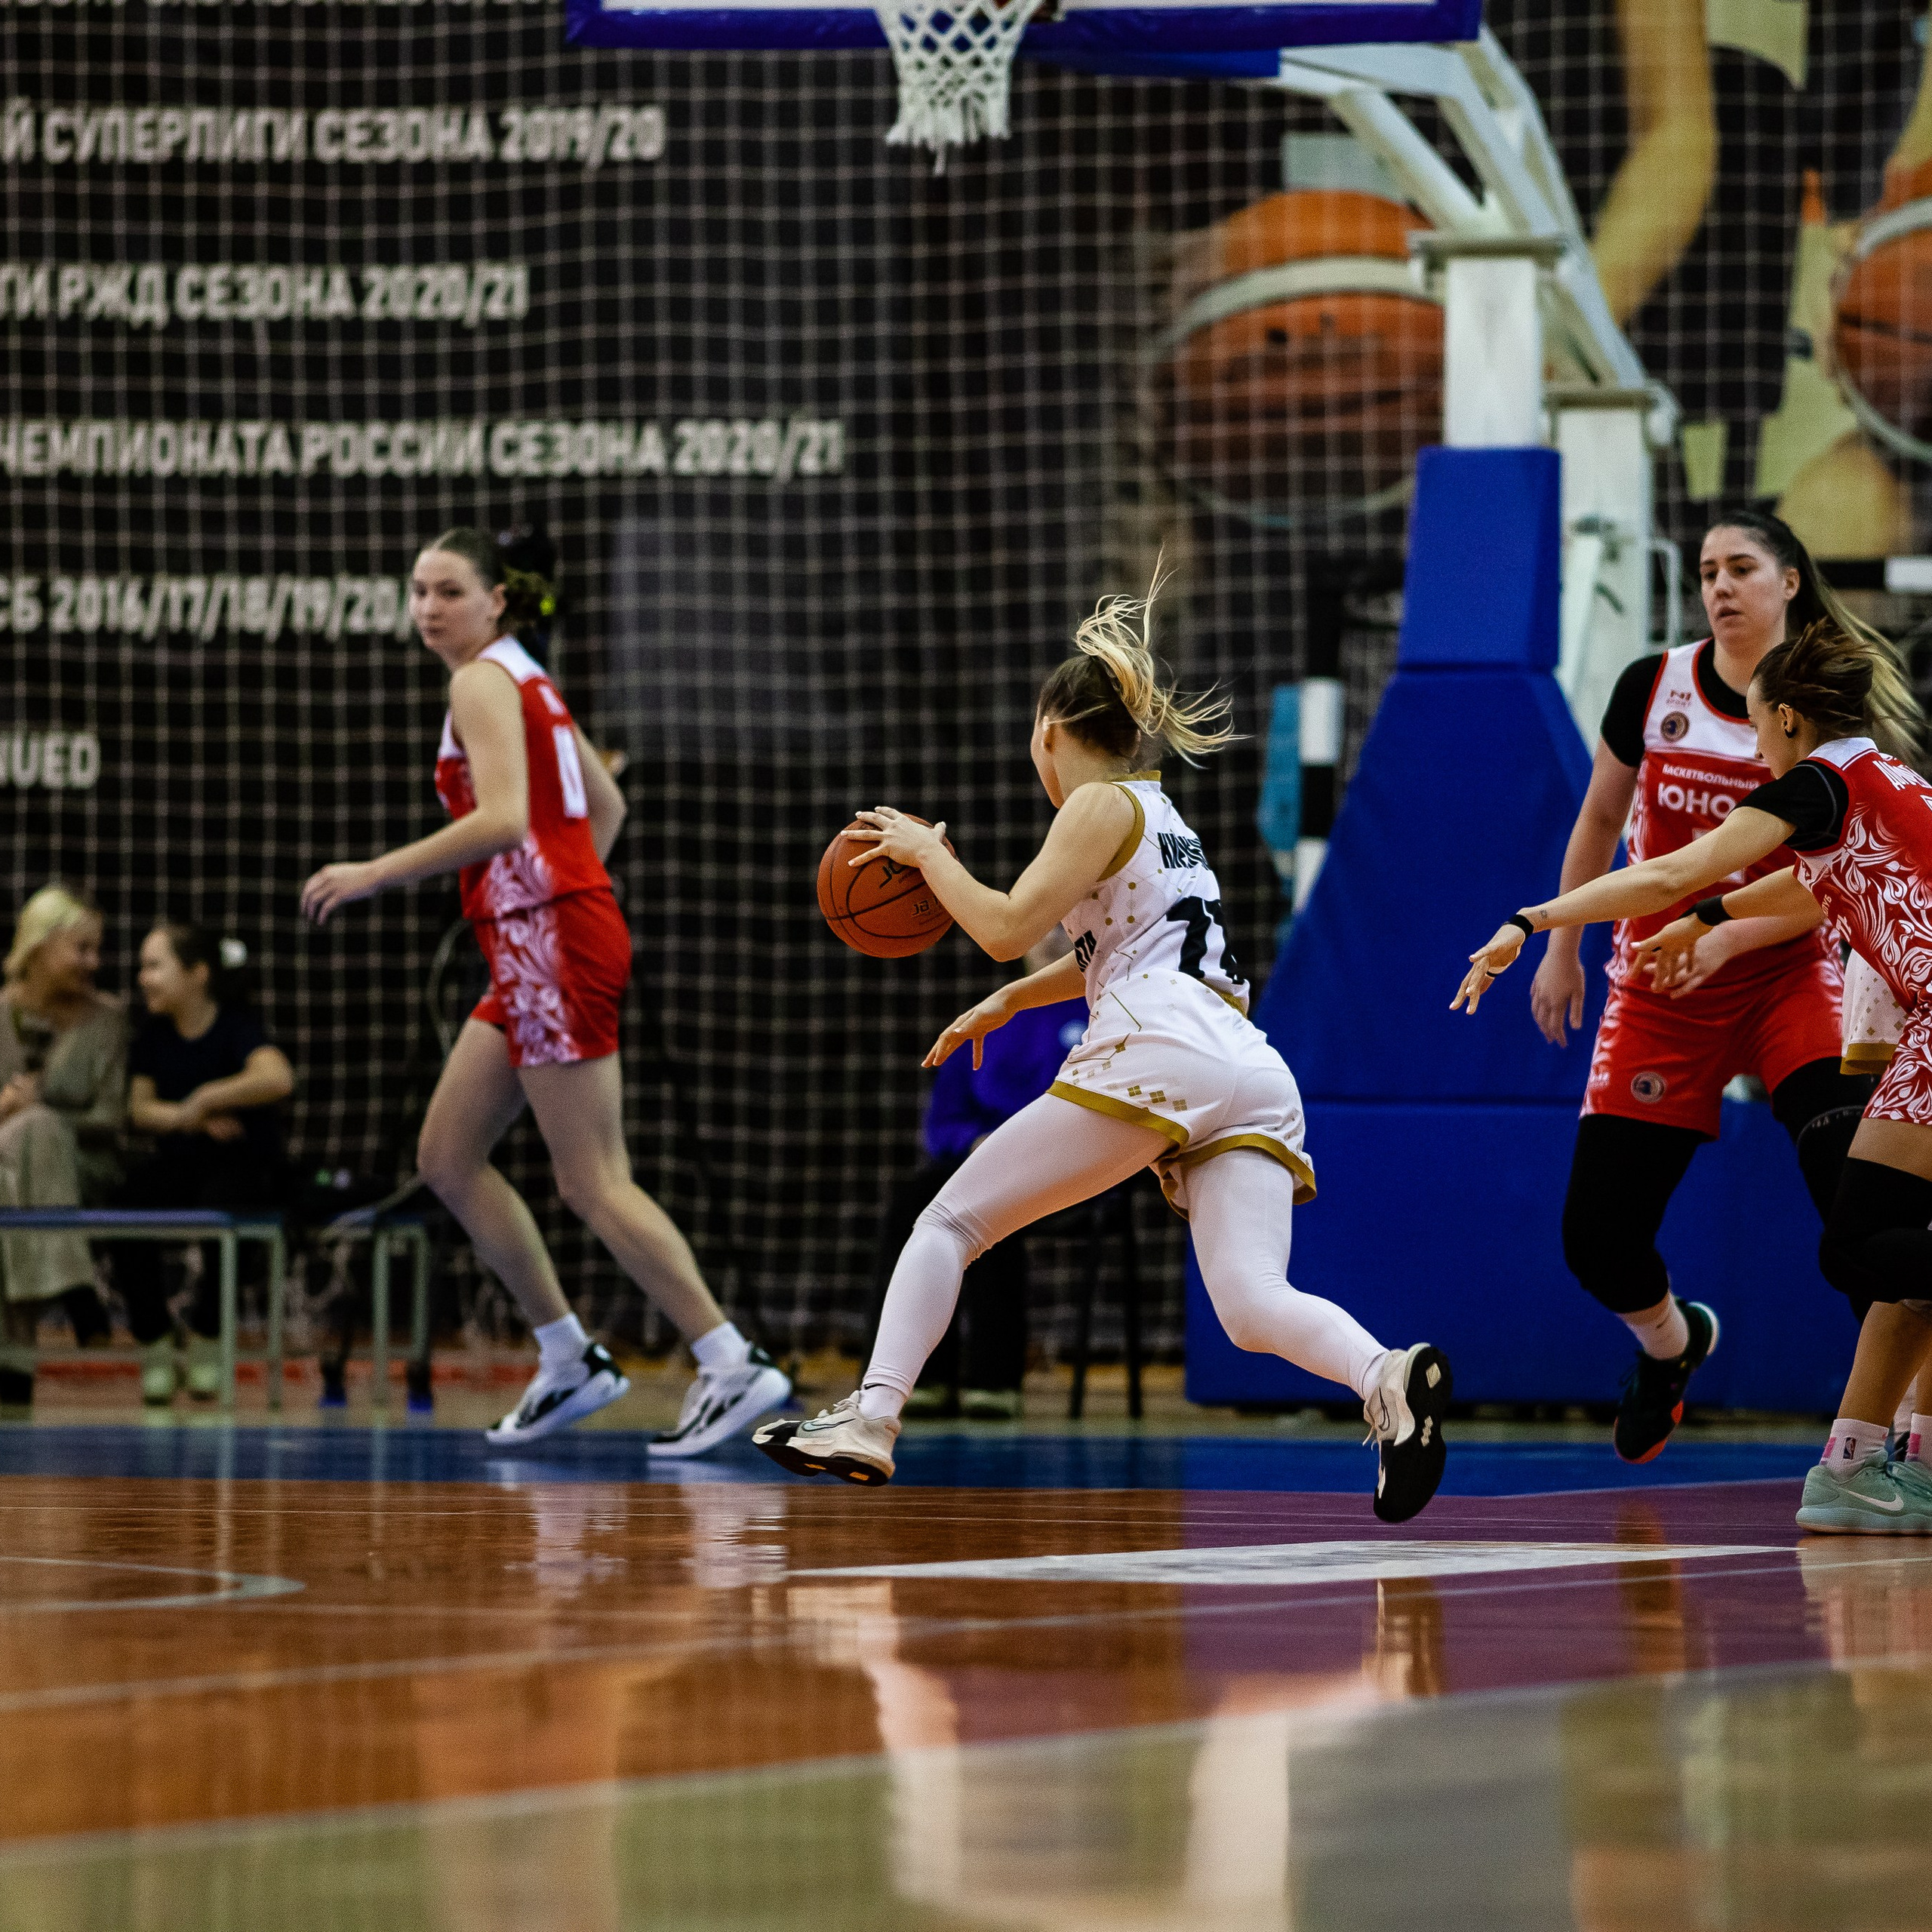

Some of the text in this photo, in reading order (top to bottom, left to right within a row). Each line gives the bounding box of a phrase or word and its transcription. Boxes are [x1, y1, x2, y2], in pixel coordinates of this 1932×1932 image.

[43, 106, 308, 164] СУПЕРЛИГИ
[314, 106, 494, 164] СЕЗОНА
[499, 105, 666, 172] 2019/20
[58, 263, 171, 331] РЖД
[175, 263, 355, 321] СЕЗОНА
[360, 261, 529, 328] 2020/21
[0, 417, 844, 483] ЧЕМПИОНАТА РОССИИ СЕЗОНА 2020/21
[0, 732, 101, 789] UED
